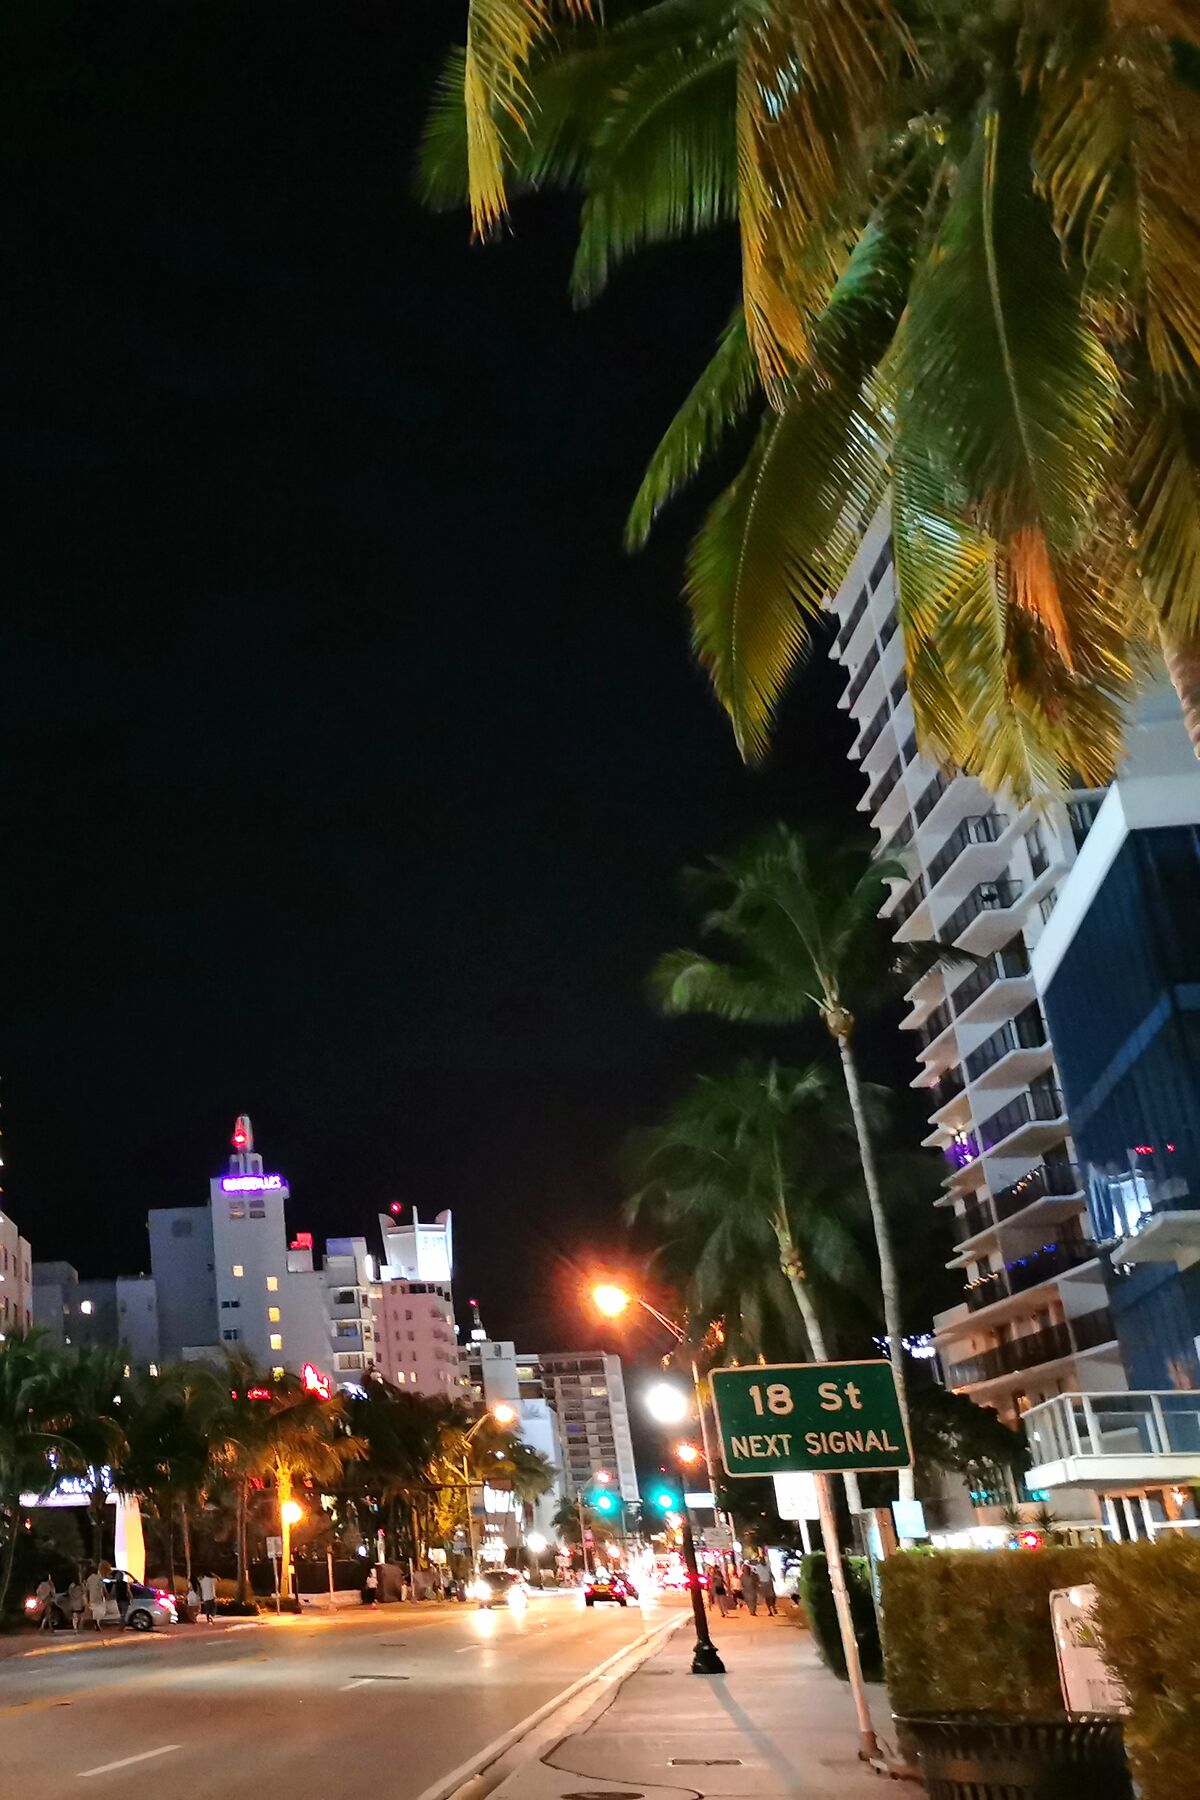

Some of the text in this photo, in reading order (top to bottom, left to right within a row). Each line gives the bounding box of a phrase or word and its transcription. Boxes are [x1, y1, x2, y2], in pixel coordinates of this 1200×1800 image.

[749, 1381, 863, 1416] 18 St
[731, 1429, 899, 1459] NEXT SIGNAL
